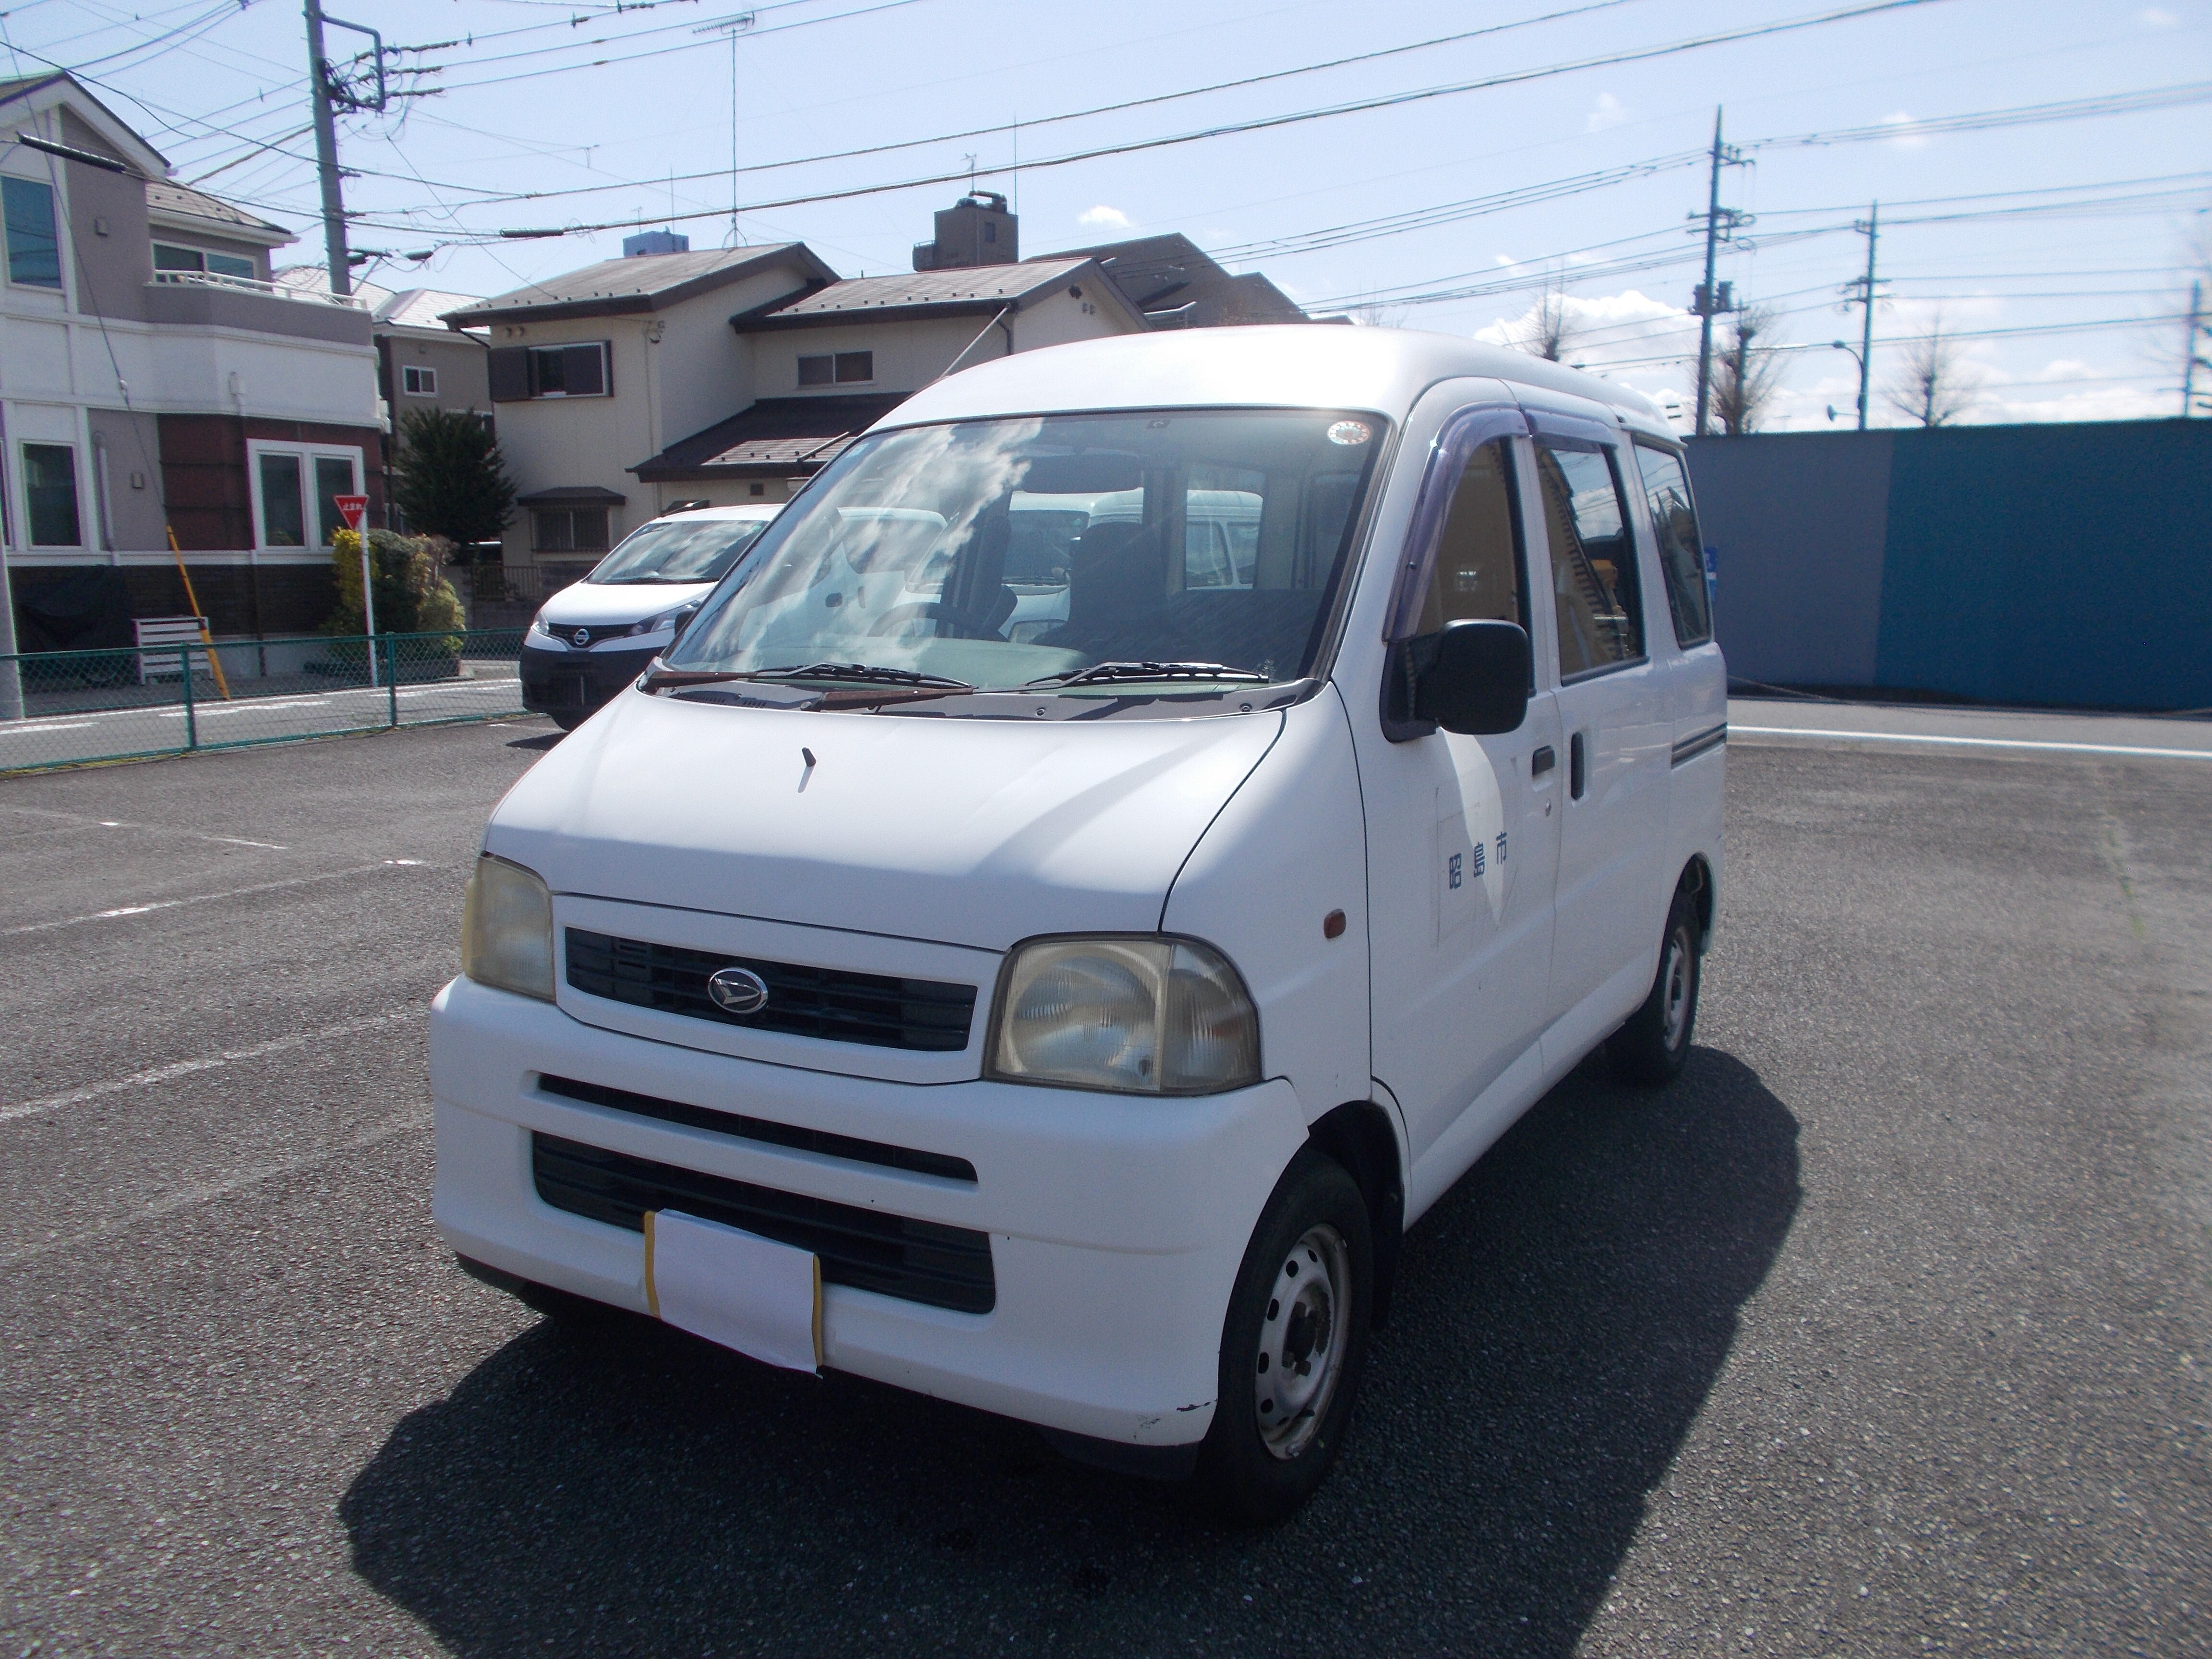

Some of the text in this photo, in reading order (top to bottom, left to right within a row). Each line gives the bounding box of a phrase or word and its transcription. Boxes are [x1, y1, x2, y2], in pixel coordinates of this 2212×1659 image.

[343, 503, 363, 511] 止まれ
[1449, 831, 1507, 890] 昭島市
